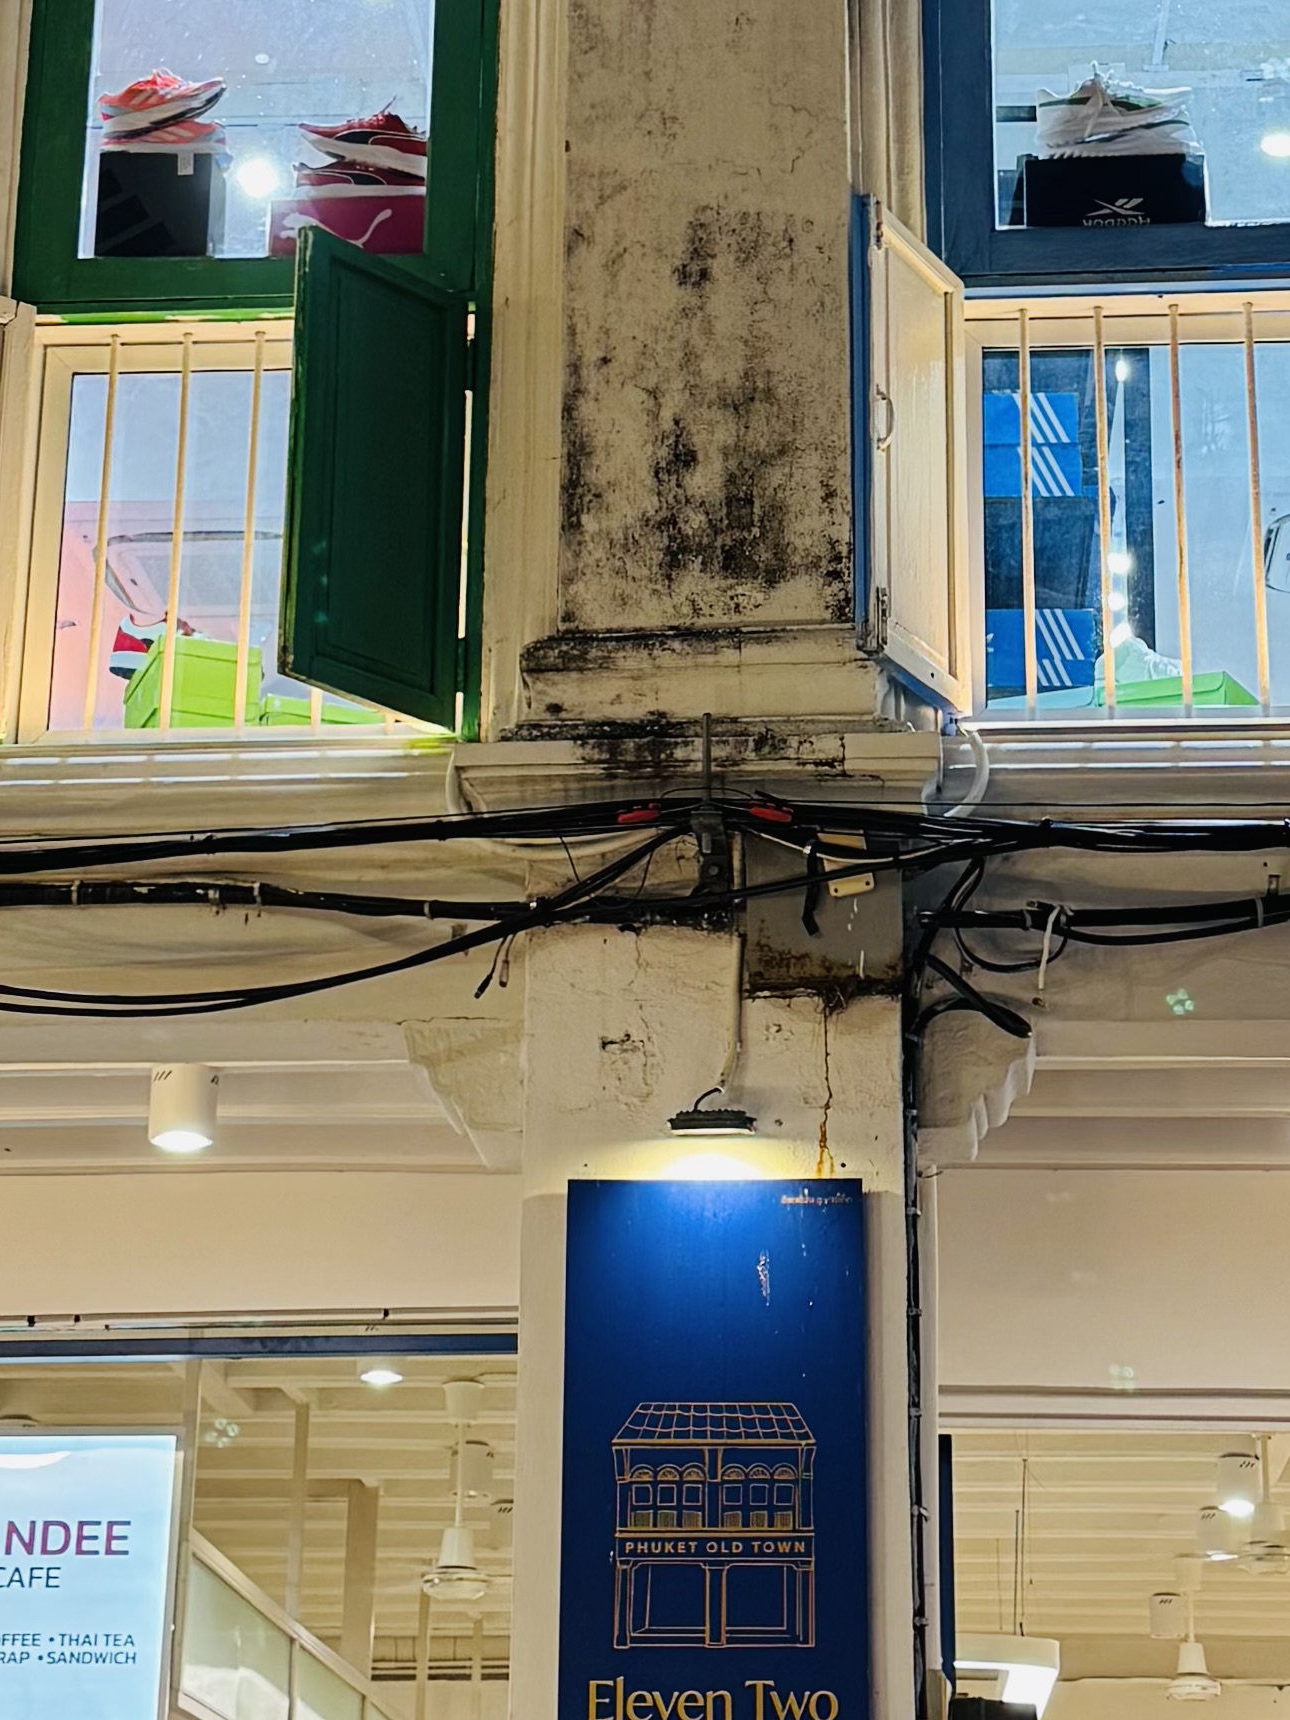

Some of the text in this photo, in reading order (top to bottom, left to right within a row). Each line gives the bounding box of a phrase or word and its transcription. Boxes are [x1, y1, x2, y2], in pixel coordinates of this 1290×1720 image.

[625, 1541, 806, 1553] PHUKET OLD TOWN
[59, 1633, 98, 1647] THAI
[103, 1633, 136, 1647] TEA
[46, 1651, 137, 1665] SANDWICH
